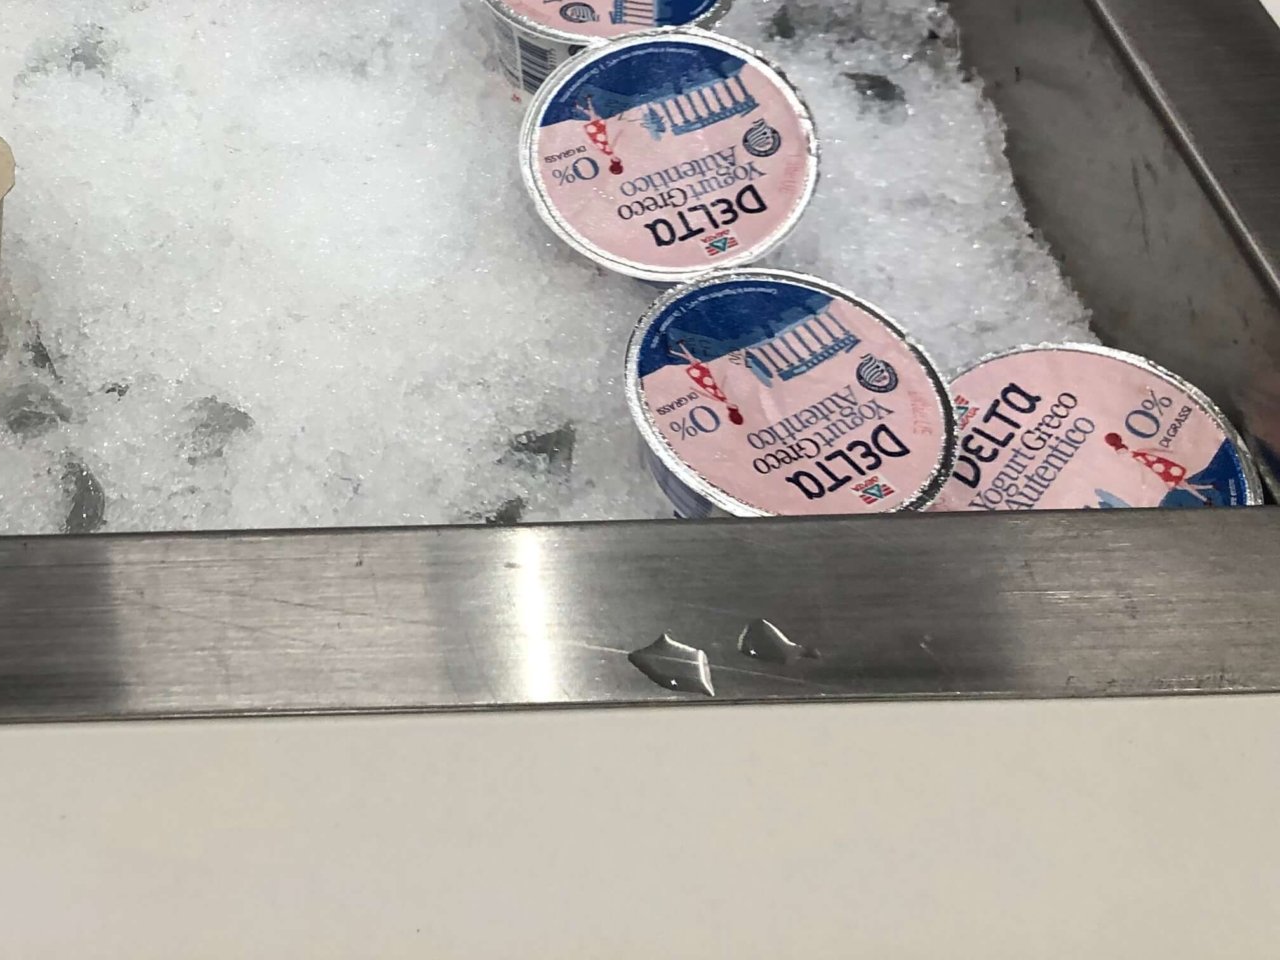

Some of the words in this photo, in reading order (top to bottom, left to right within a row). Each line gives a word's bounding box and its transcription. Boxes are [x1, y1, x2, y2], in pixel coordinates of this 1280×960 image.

[551, 154, 600, 187] 0%
[620, 144, 738, 198] Autentico
[643, 183, 768, 248] DELTA
[669, 403, 722, 441] 0%
[746, 383, 861, 451] Autentico
[1123, 389, 1174, 440] 0%
[1159, 434, 1171, 449] DI
[1168, 405, 1193, 435] GRASSI
[784, 423, 911, 501] DELTA
